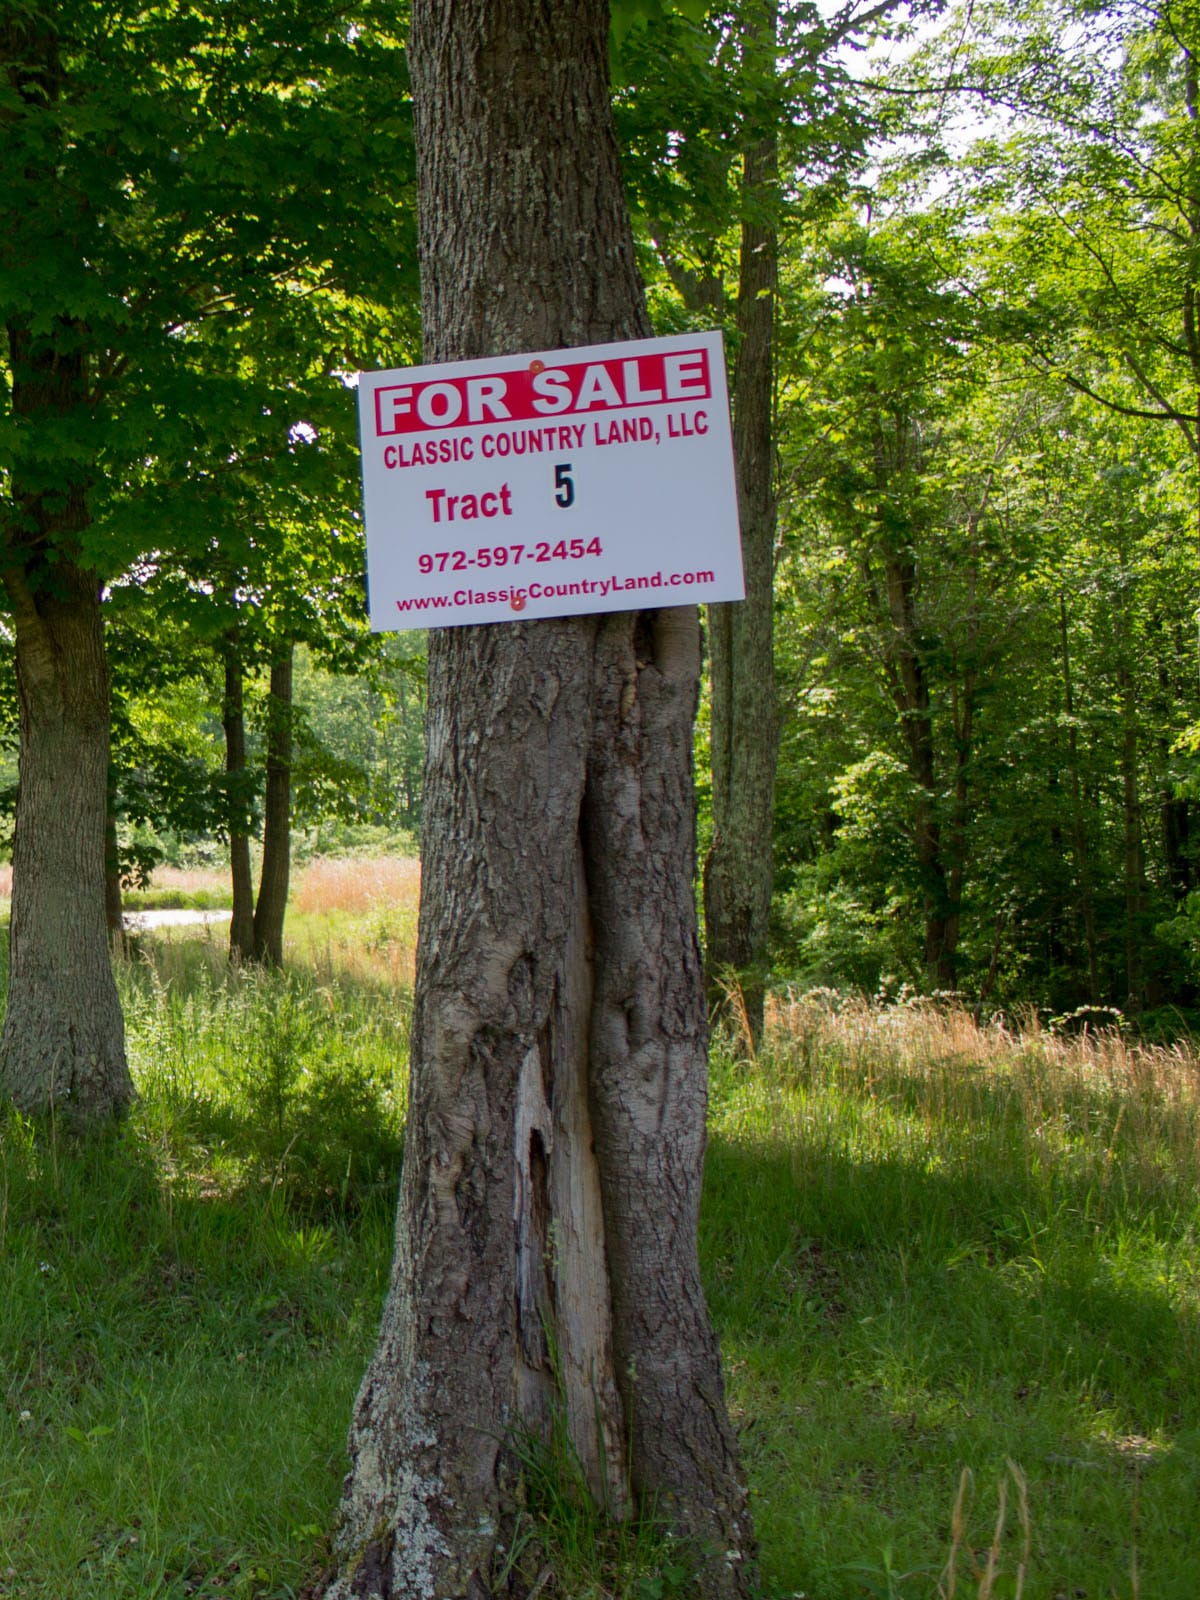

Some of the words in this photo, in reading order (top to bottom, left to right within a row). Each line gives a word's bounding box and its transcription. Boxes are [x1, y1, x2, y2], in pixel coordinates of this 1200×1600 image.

[378, 376, 512, 433] FOR
[531, 352, 707, 415] SALE
[383, 436, 475, 469] CLASSIC
[481, 423, 587, 458] COUNTRY
[594, 416, 661, 446] LAND,
[667, 410, 710, 438] LLC
[425, 482, 513, 523] Tract
[553, 463, 576, 509] 5
[417, 536, 604, 574] 972-597-2454
[396, 568, 716, 612] www.ClassicCountryLand.com
